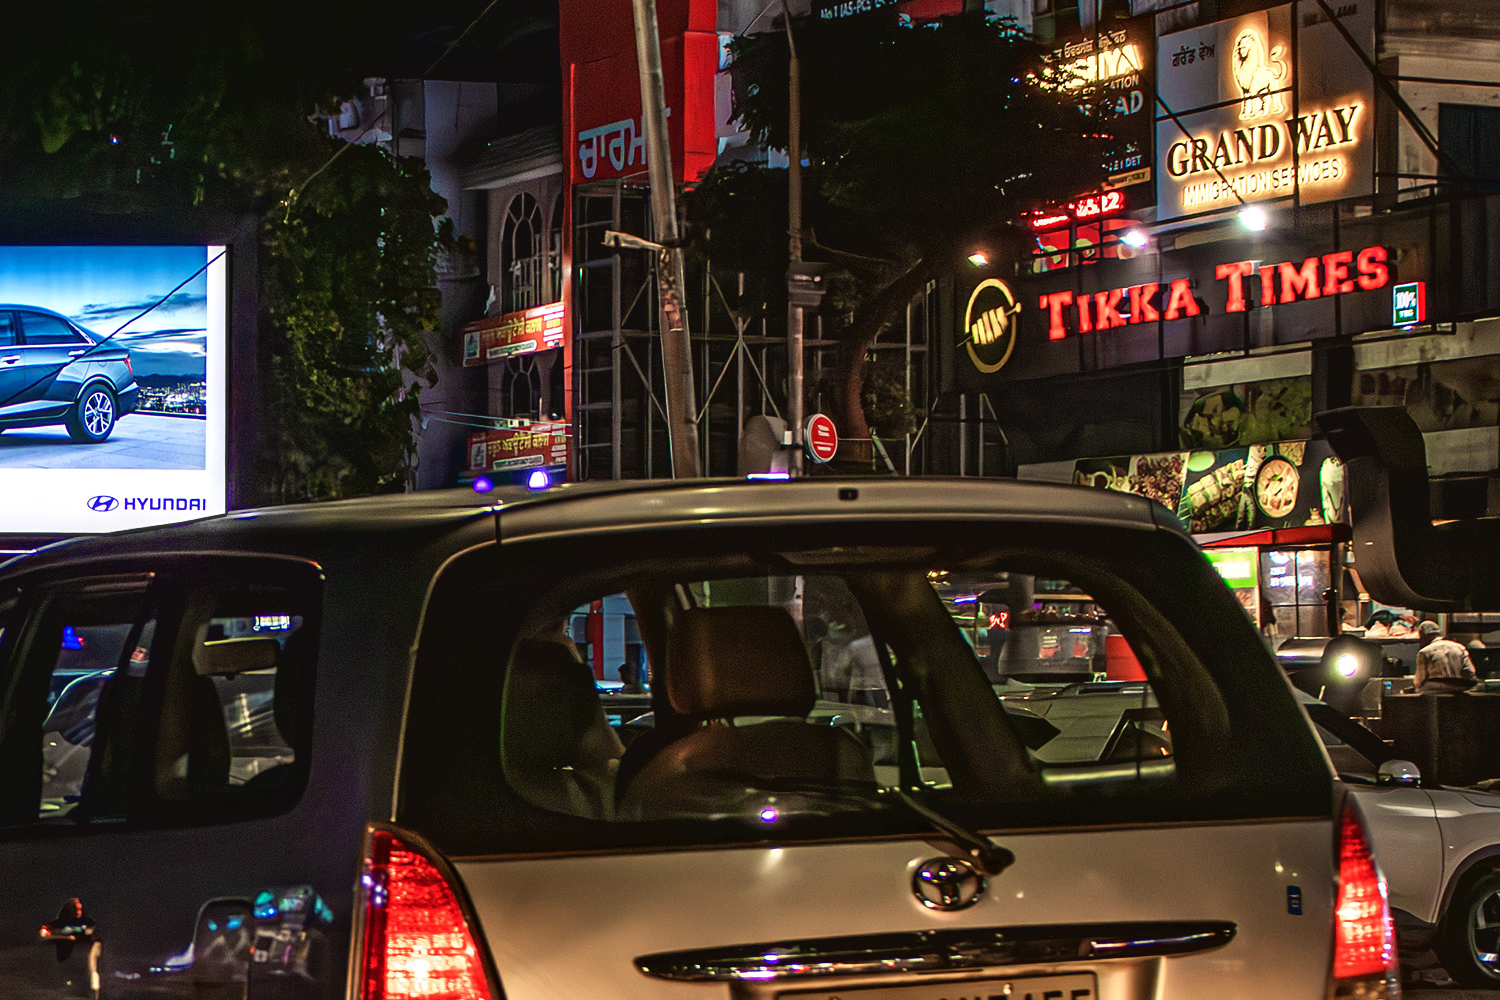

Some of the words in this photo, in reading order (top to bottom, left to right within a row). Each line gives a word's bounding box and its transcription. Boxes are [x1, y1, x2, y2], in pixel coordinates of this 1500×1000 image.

[1167, 124, 1280, 177] GRAND
[1285, 104, 1359, 153] WAY
[1184, 171, 1271, 207] IMMIGRATION
[1272, 158, 1342, 190] SERVICES
[1039, 277, 1201, 340] TIKKA
[1215, 246, 1389, 314] TIMES
[124, 497, 206, 511] HYUNDAI
